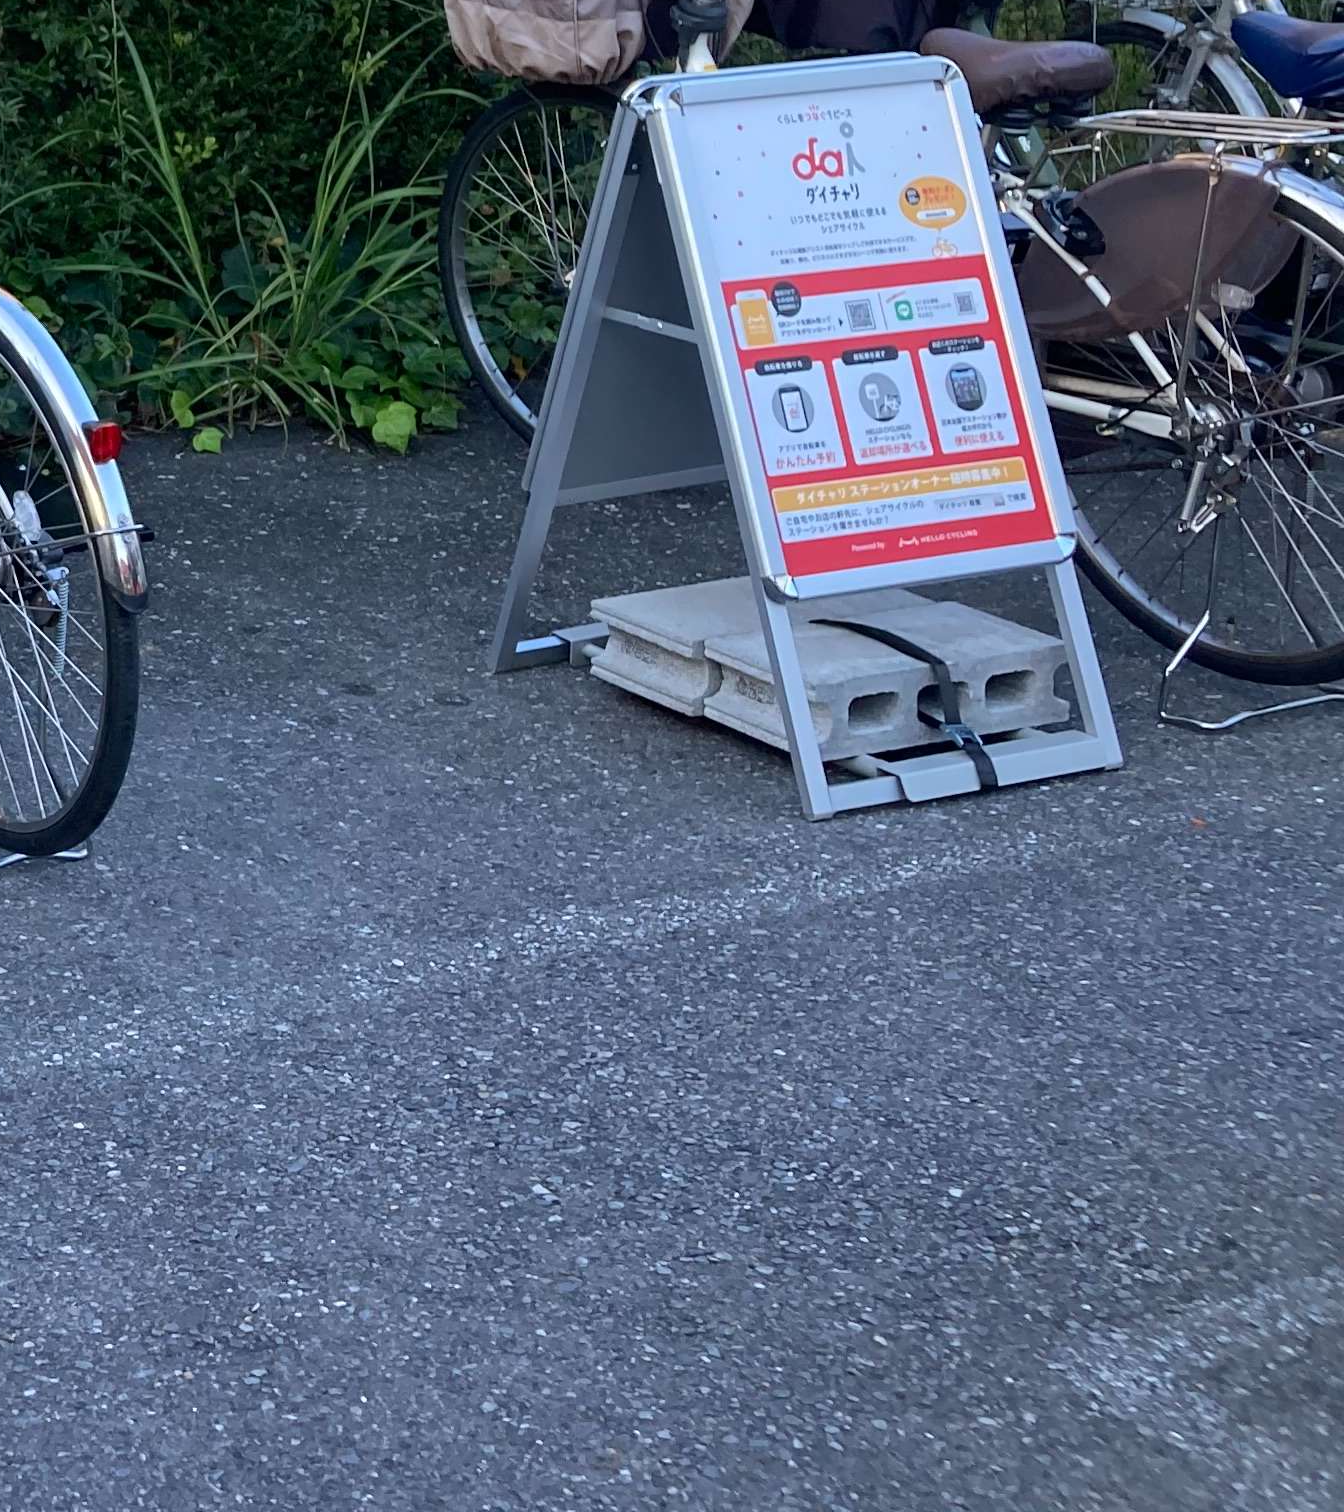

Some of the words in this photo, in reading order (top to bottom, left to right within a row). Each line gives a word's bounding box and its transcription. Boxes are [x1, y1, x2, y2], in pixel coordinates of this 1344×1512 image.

[792, 122, 866, 180] dai
[806, 182, 861, 205] ダイチャリ
[790, 207, 887, 225] いつでもどこでも気軽に使える
[821, 222, 866, 235] シェアサイクル
[775, 451, 836, 469] かんたん予約
